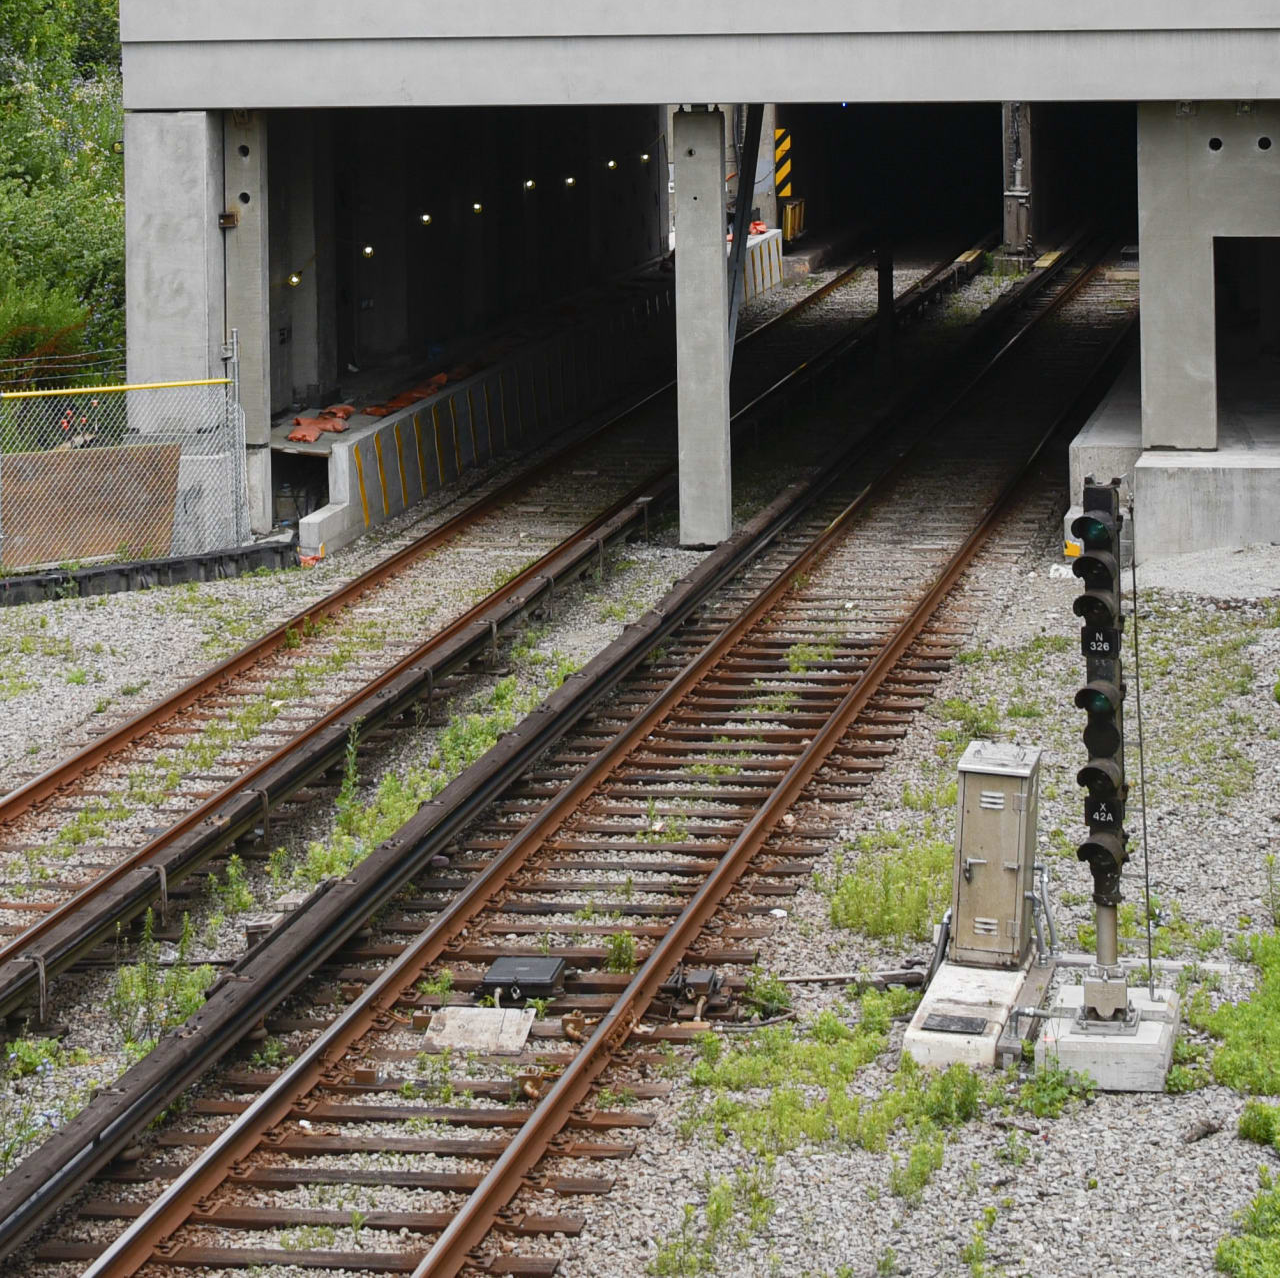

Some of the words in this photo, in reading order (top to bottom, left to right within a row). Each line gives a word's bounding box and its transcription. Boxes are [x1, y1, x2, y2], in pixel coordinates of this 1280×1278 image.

[1095, 632, 1103, 641] N
[1090, 642, 1110, 651] 326
[1100, 802, 1106, 812] X
[1092, 812, 1114, 822] 42A
